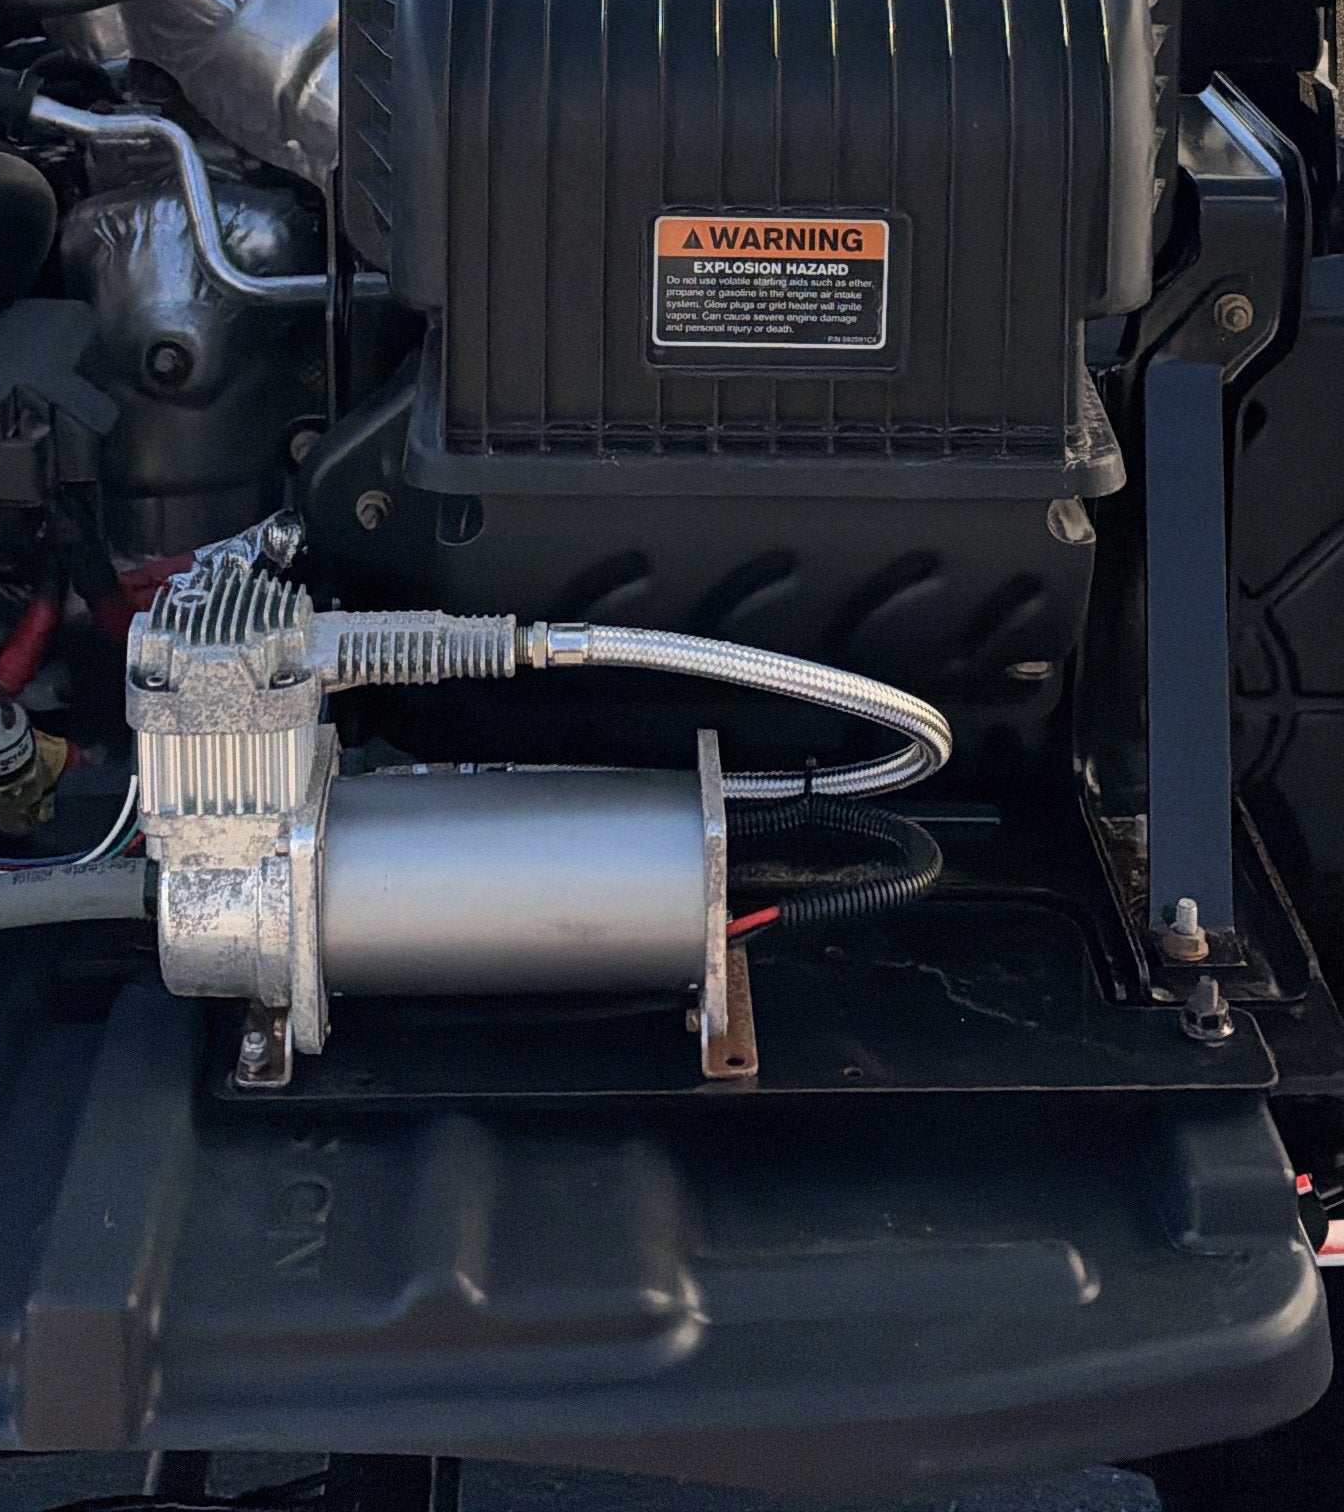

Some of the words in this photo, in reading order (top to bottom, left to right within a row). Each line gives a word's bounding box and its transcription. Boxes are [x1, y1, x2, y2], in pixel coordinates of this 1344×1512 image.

[709, 226, 863, 252] WARNING
[693, 261, 781, 275] EXPLOSION
[786, 263, 849, 276] HAZARD
[666, 276, 679, 285] Do
[682, 277, 697, 285] not
[719, 277, 750, 286] volatile
[753, 277, 787, 288] starting
[789, 278, 808, 287] aids
[810, 278, 832, 287] such
[666, 289, 704, 299] propane
[718, 289, 757, 299] gasoline
[759, 289, 768, 297] in
[769, 289, 784, 298] the
[786, 290, 818, 300] engine
[820, 291, 832, 299] air
[834, 290, 862, 299] intake
[703, 300, 728, 308] Glow
[729, 300, 755, 311] plugs
[768, 300, 786, 311] grid
[788, 301, 818, 311] heater
[820, 302, 835, 311] will
[837, 302, 862, 313] ignite
[701, 311, 721, 321] Can
[723, 313, 751, 321] cause
[786, 313, 818, 323] engine
[820, 314, 857, 324] damage
[665, 323, 683, 332] and
[685, 324, 725, 333] personal
[726, 324, 753, 334] injury
[766, 325, 794, 334] death.
